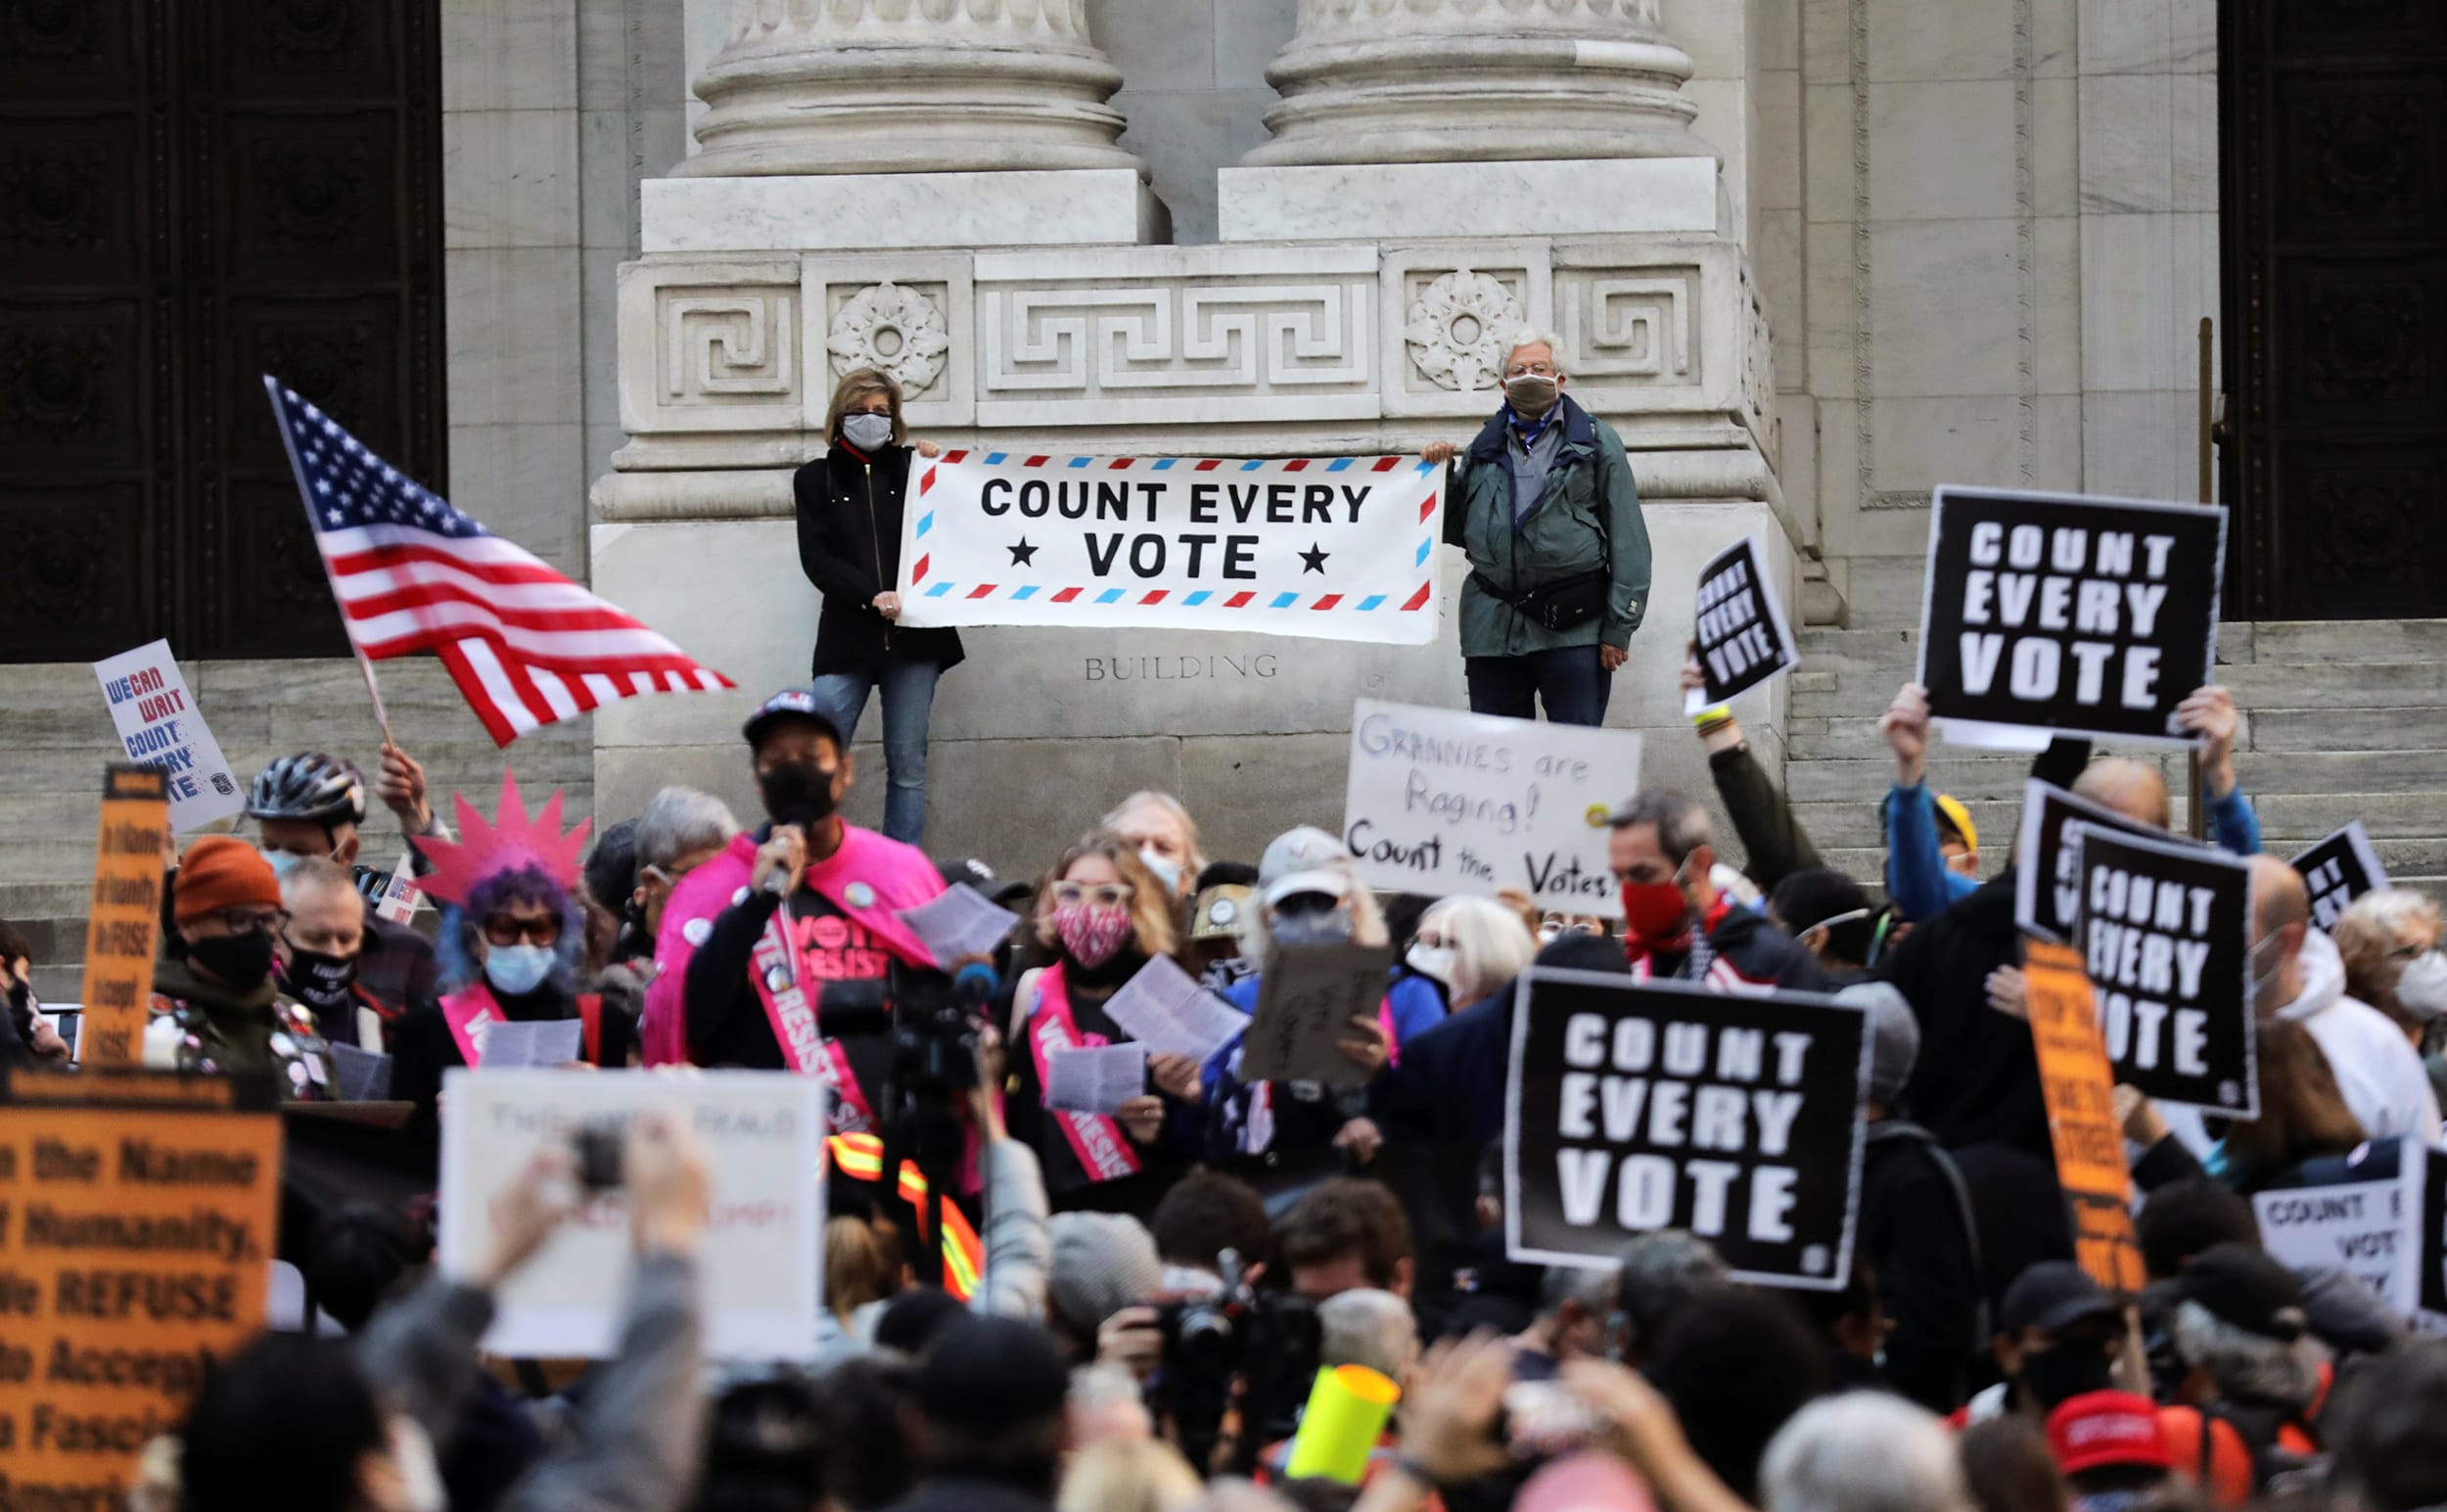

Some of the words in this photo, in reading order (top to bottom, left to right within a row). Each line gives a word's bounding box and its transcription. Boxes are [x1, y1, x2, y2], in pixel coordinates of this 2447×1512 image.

[981, 479, 1168, 522] COUNT
[1189, 483, 1372, 524] EVERY
[1084, 532, 1260, 579] VOTE
[1968, 520, 2176, 580] COUNT
[1697, 587, 1757, 649] EVERY
[1962, 568, 2169, 638] EVERY
[1085, 655, 1277, 681] BUILDING
[1706, 620, 1774, 685] VOTE
[1959, 630, 2163, 710] VOTE
[138, 688, 186, 724] WAIT
[125, 719, 182, 759] COUNT
[1359, 712, 1514, 773] GRANNIES
[1534, 755, 1590, 782] are
[167, 775, 199, 802] TE
[1405, 767, 1541, 833] Raging!
[1347, 818, 1442, 871] Count
[2089, 864, 2216, 937] COUNT
[2087, 916, 2211, 1000] EVERY
[773, 985, 840, 1083] RESIST
[1563, 1012, 1814, 1086] COUNT
[2097, 986, 2210, 1077] OTE
[1557, 1072, 1805, 1157] EVERY
[32, 1135, 101, 1183] the
[118, 1135, 259, 1188] Name
[1555, 1147, 1799, 1244] VOTE
[2266, 1193, 2365, 1225] COUNT
[2335, 1229, 2397, 1260] VOT
[56, 1270, 239, 1322] REFUSE
[48, 1337, 211, 1397] Accep
